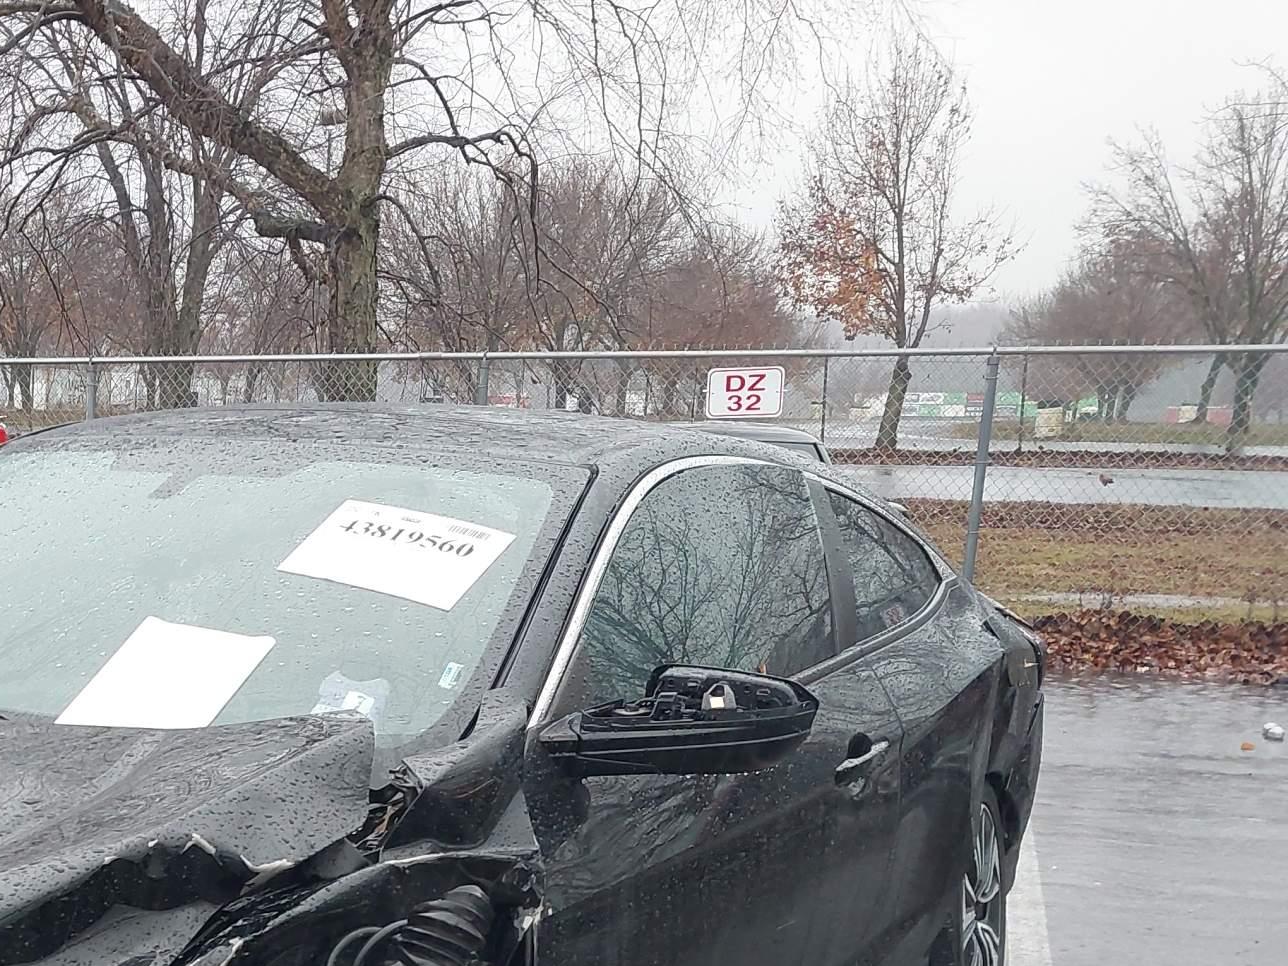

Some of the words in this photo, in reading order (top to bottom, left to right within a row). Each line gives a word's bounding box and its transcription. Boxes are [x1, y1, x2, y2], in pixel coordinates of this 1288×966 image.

[725, 373, 767, 392] DZ
[726, 393, 762, 412] 32
[339, 519, 475, 558] 43819560
